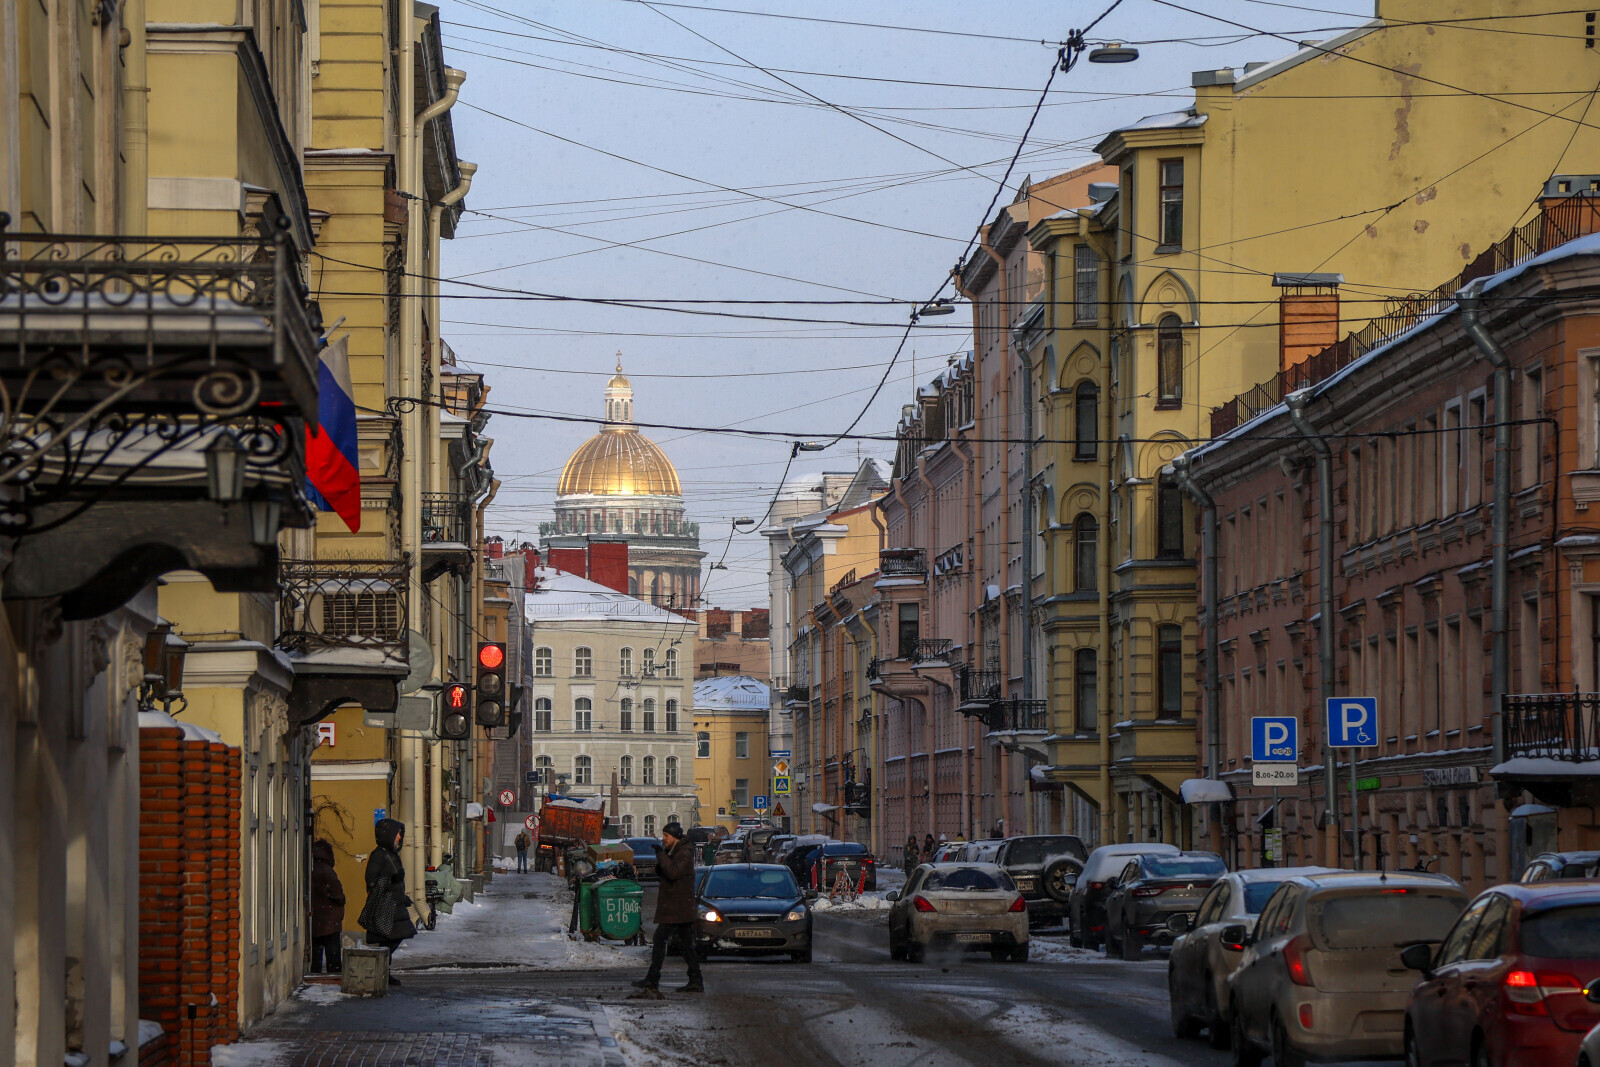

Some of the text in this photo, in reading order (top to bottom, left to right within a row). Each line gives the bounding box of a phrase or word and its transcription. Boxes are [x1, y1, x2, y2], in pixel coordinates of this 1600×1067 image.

[1341, 703, 1368, 741] P
[1264, 722, 1289, 757] P
[1255, 771, 1295, 779] 8.00-20.00
[756, 797, 765, 808] P
